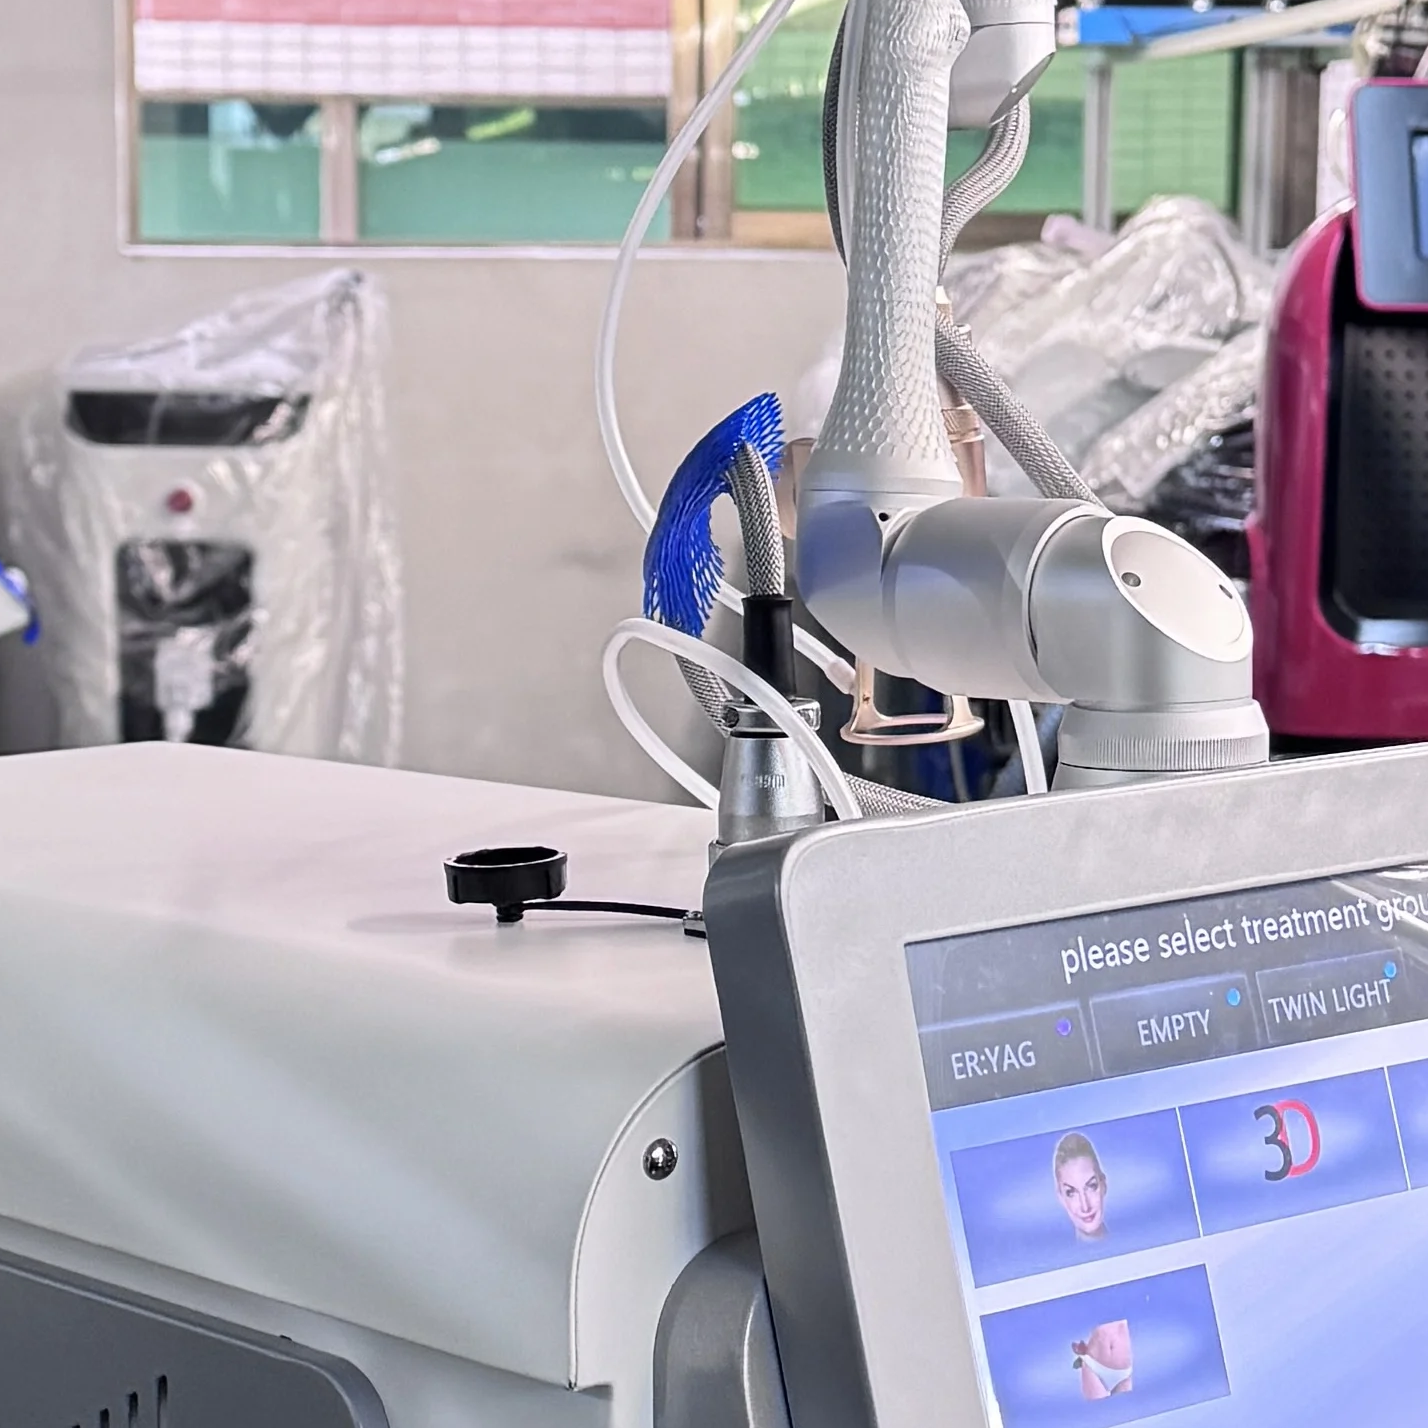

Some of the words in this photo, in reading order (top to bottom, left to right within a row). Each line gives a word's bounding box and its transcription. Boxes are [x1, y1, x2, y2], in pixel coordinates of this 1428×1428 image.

[1061, 936, 1150, 984] please
[1158, 918, 1237, 959] select
[1241, 899, 1370, 945] treatment
[1268, 990, 1327, 1023] TWIN
[1332, 979, 1391, 1013] LIGHT
[1137, 1009, 1210, 1046] EMPTY
[951, 1041, 1036, 1080] ER:YAG
[1254, 1099, 1320, 1181] 3D
